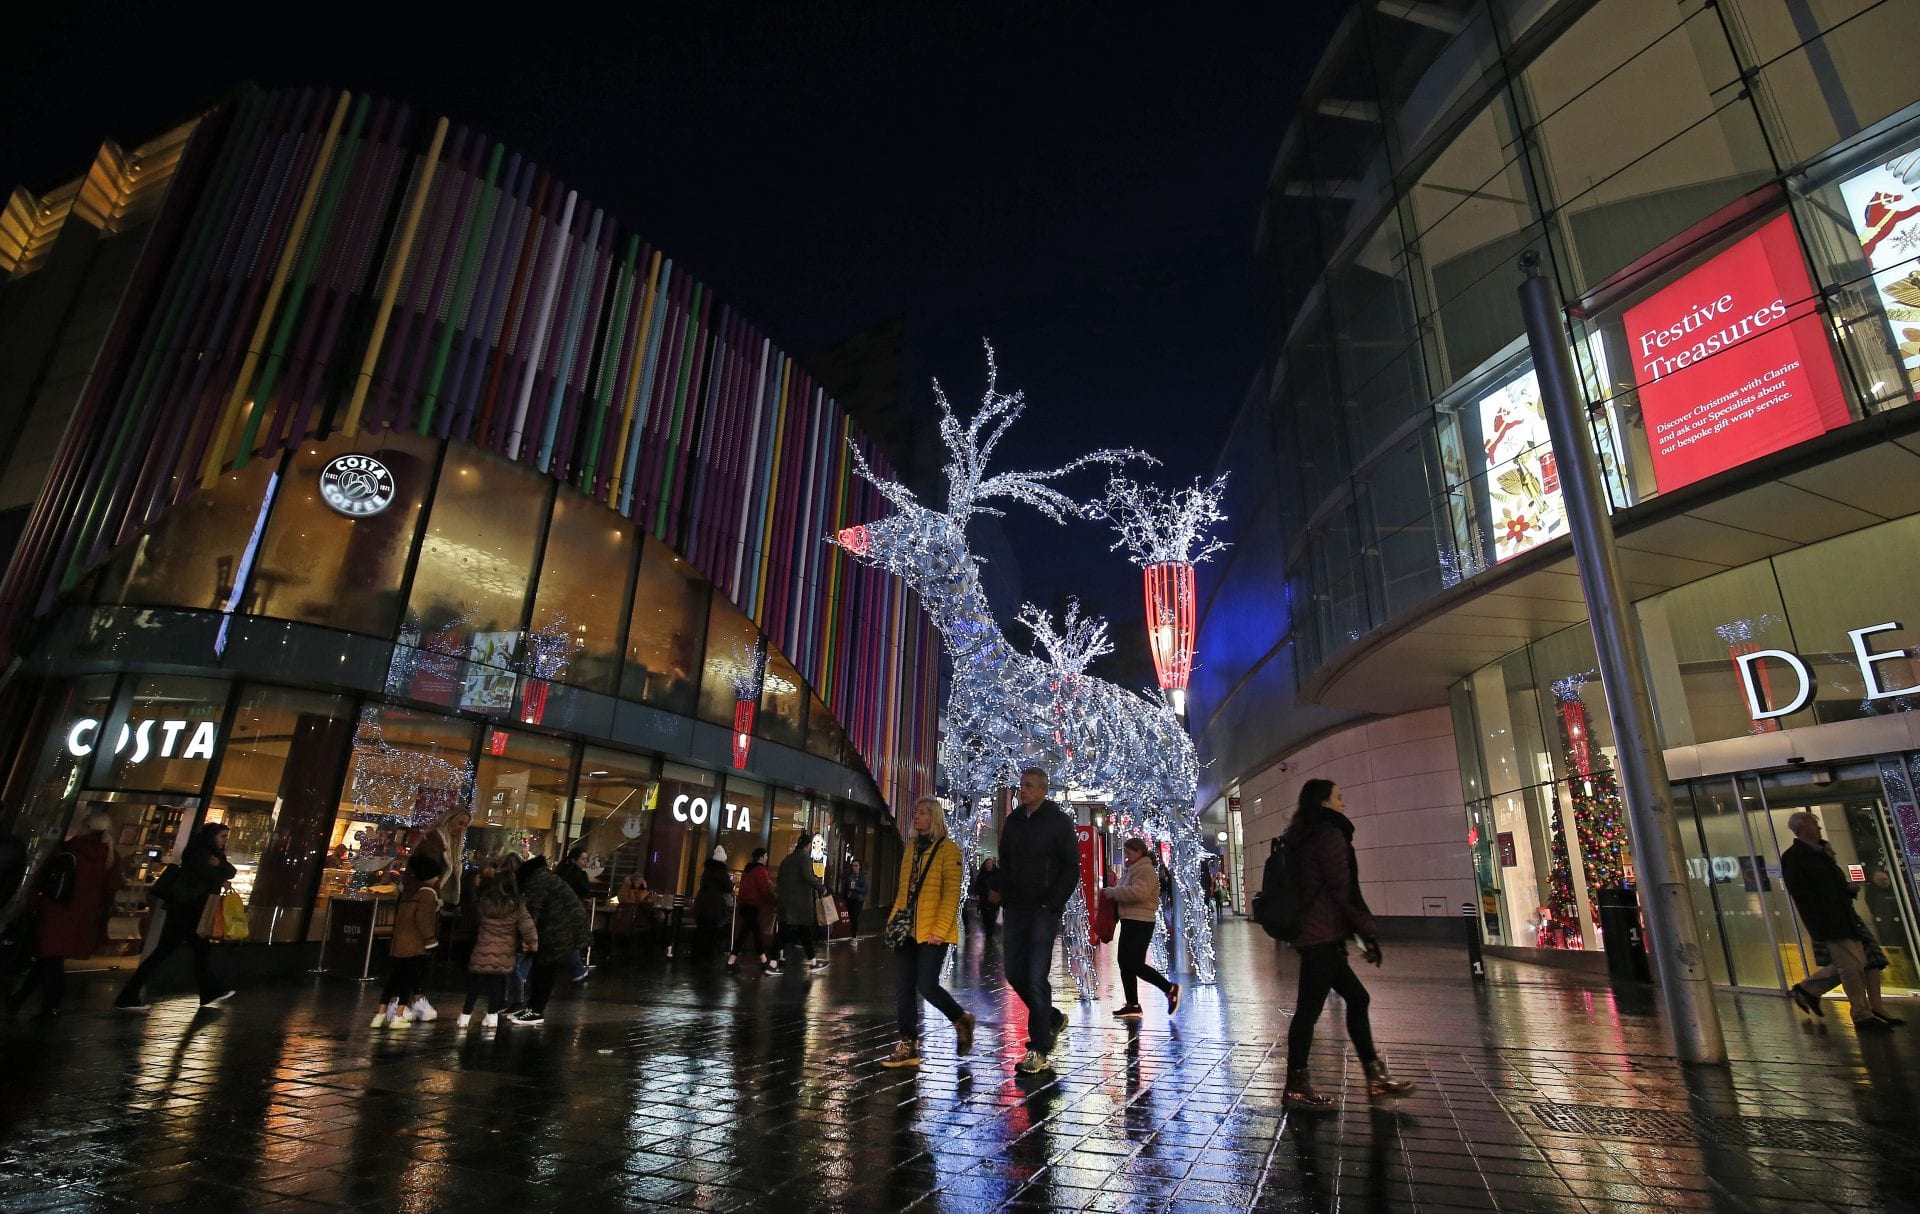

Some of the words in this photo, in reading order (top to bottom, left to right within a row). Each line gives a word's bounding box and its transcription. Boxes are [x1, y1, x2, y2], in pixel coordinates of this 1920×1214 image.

[1639, 295, 1733, 358] Festive
[1644, 299, 1786, 384] Treasures
[1657, 412, 1692, 433] Discover
[1694, 390, 1739, 415] Christmas
[1740, 378, 1762, 393] with
[1763, 361, 1799, 381] Clarins
[1659, 430, 1675, 444] and
[1676, 424, 1691, 436] ask
[1692, 417, 1708, 428] our
[1708, 395, 1756, 421] Specialists
[1757, 380, 1786, 398] about
[1661, 444, 1676, 455] our
[1677, 427, 1713, 448] bespoke
[1714, 418, 1729, 433] gift
[1730, 409, 1755, 423] wrap
[1756, 391, 1792, 412] service.
[325, 484, 386, 512] COFFEE
[335, 457, 386, 480] COSTA
[672, 794, 751, 832] COTA
[1473, 961, 1484, 975] 1
